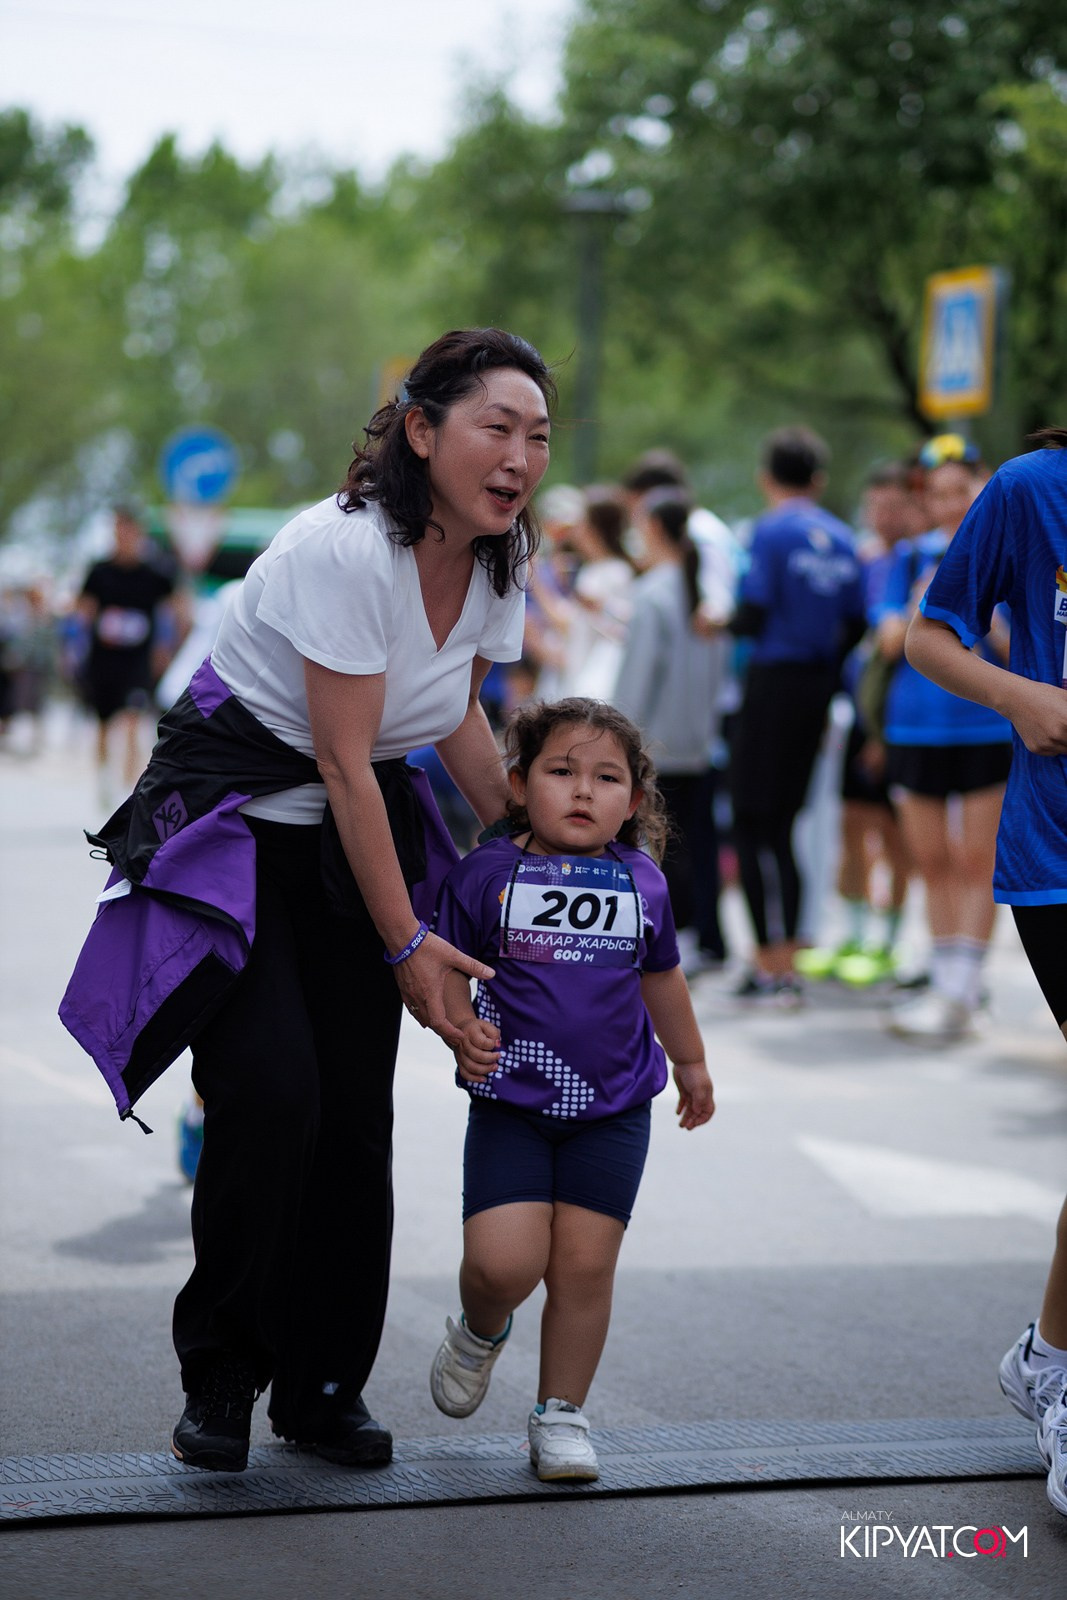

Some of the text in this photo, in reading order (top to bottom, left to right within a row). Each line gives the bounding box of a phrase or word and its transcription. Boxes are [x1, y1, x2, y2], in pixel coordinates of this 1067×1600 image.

[531, 890, 618, 931] 201
[507, 930, 637, 952] БАЛАЛАР ЖАРЫСЫ
[553, 949, 582, 961] 600
